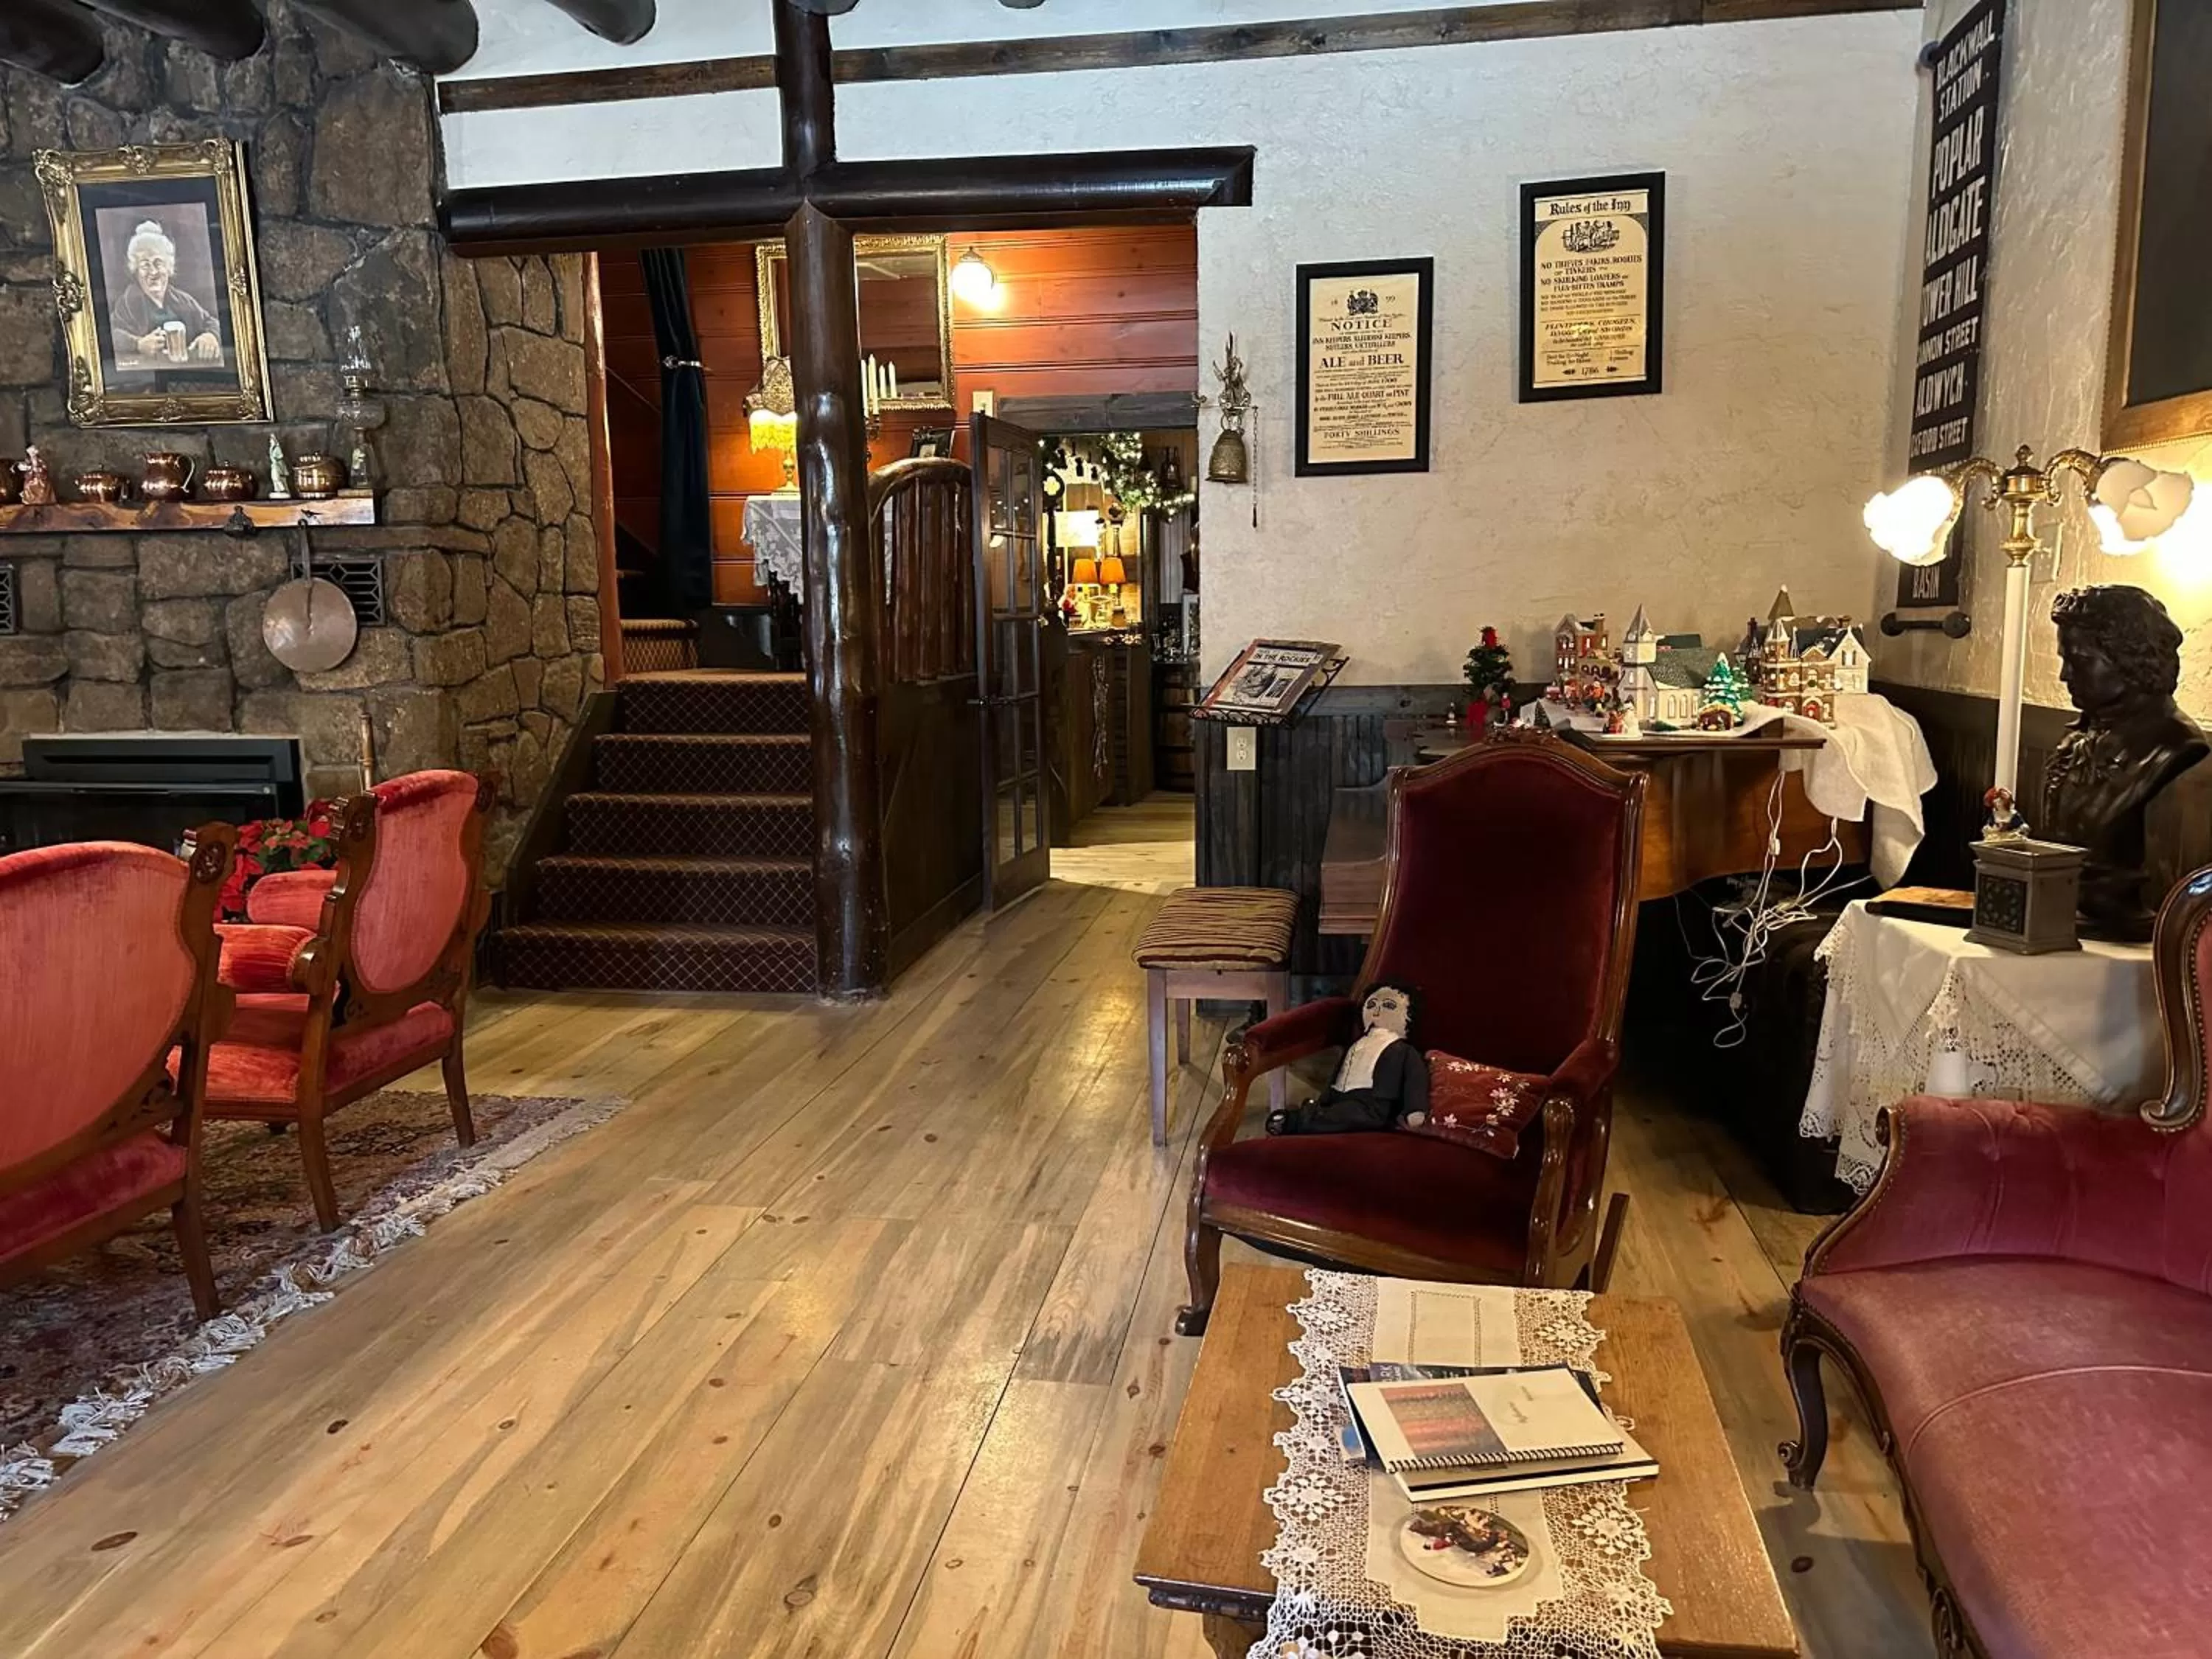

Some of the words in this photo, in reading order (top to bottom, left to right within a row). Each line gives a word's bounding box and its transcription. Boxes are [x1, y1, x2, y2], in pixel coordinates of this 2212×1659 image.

[1938, 58, 1983, 123] STATION
[1932, 105, 1984, 199] POPLAR
[1549, 202, 1582, 216] Rules
[1583, 202, 1590, 214] of
[1593, 200, 1608, 211] the
[1611, 198, 1631, 212] Inn
[1926, 175, 1986, 266] ALDGATE
[1541, 278, 1551, 286] NO
[1954, 255, 1978, 311] HILL
[1331, 319, 1393, 331] NOTICE
[1918, 333, 1944, 366] ANNON
[1944, 316, 1979, 354] STREET
[1321, 356, 1346, 368] ALE
[1349, 356, 1365, 366] and
[1368, 353, 1404, 366] BEER
[1915, 361, 1964, 418] ALDWYCH
[1354, 428, 1400, 437] SHILLINGS
[1938, 417, 1968, 449] STREET
[1913, 566, 1940, 599] BASIN
